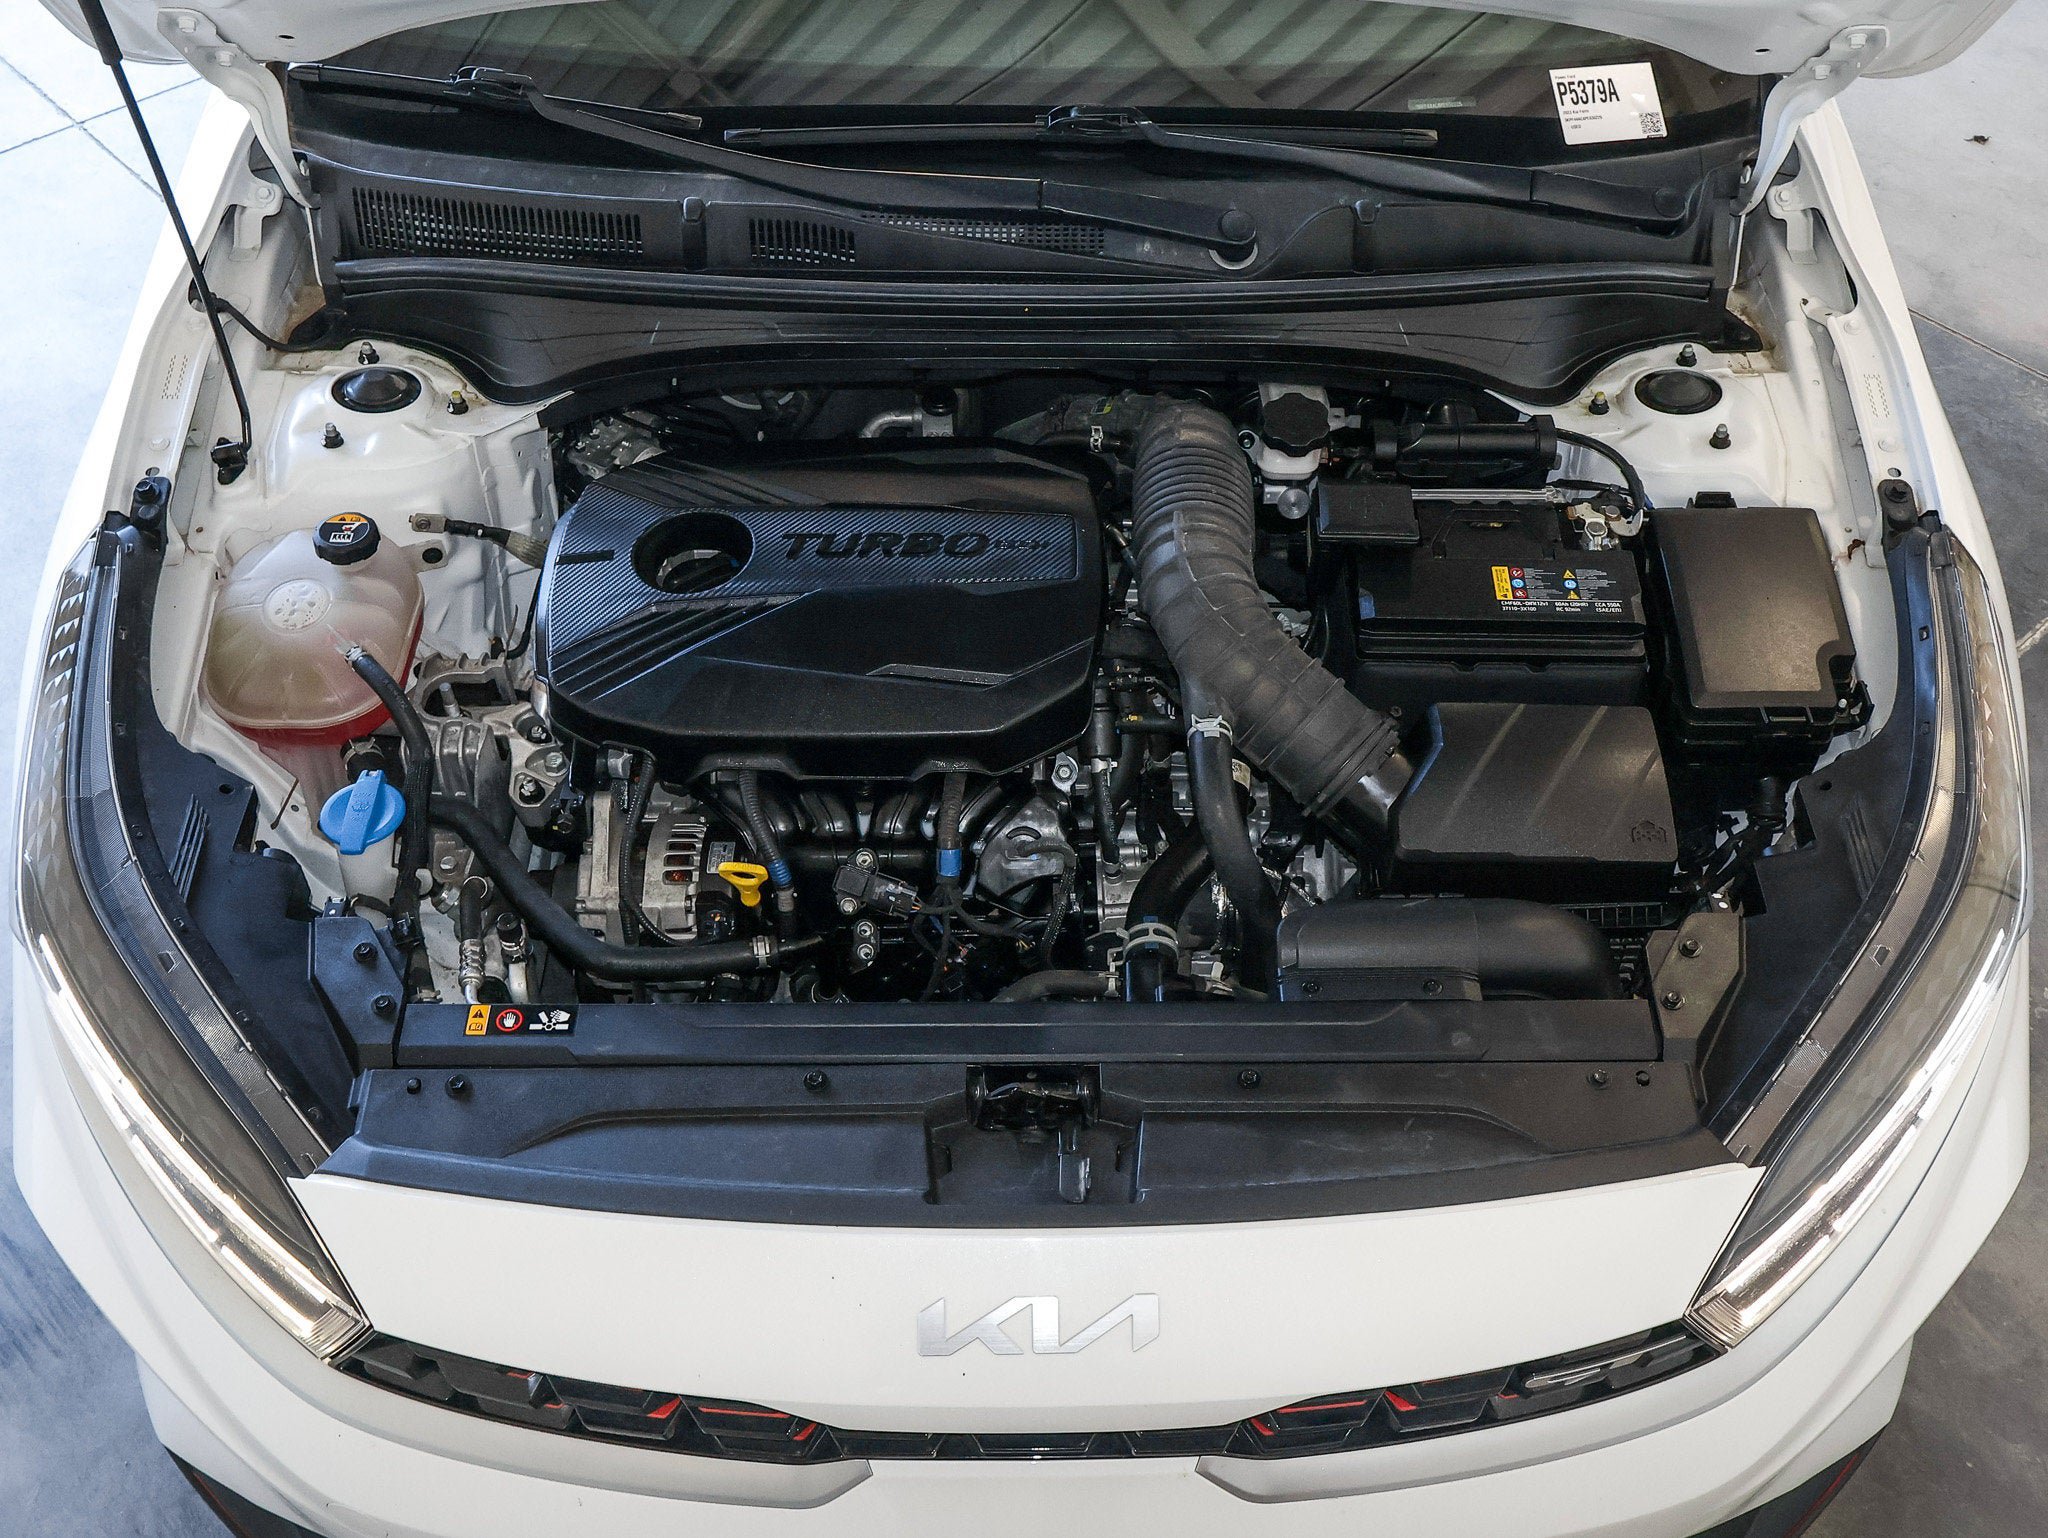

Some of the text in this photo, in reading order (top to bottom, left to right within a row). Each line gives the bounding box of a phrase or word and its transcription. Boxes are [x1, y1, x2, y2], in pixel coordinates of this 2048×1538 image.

[1556, 78, 1620, 106] P5379A
[782, 532, 991, 560] TURBO
[917, 1293, 1160, 1356] KIA
